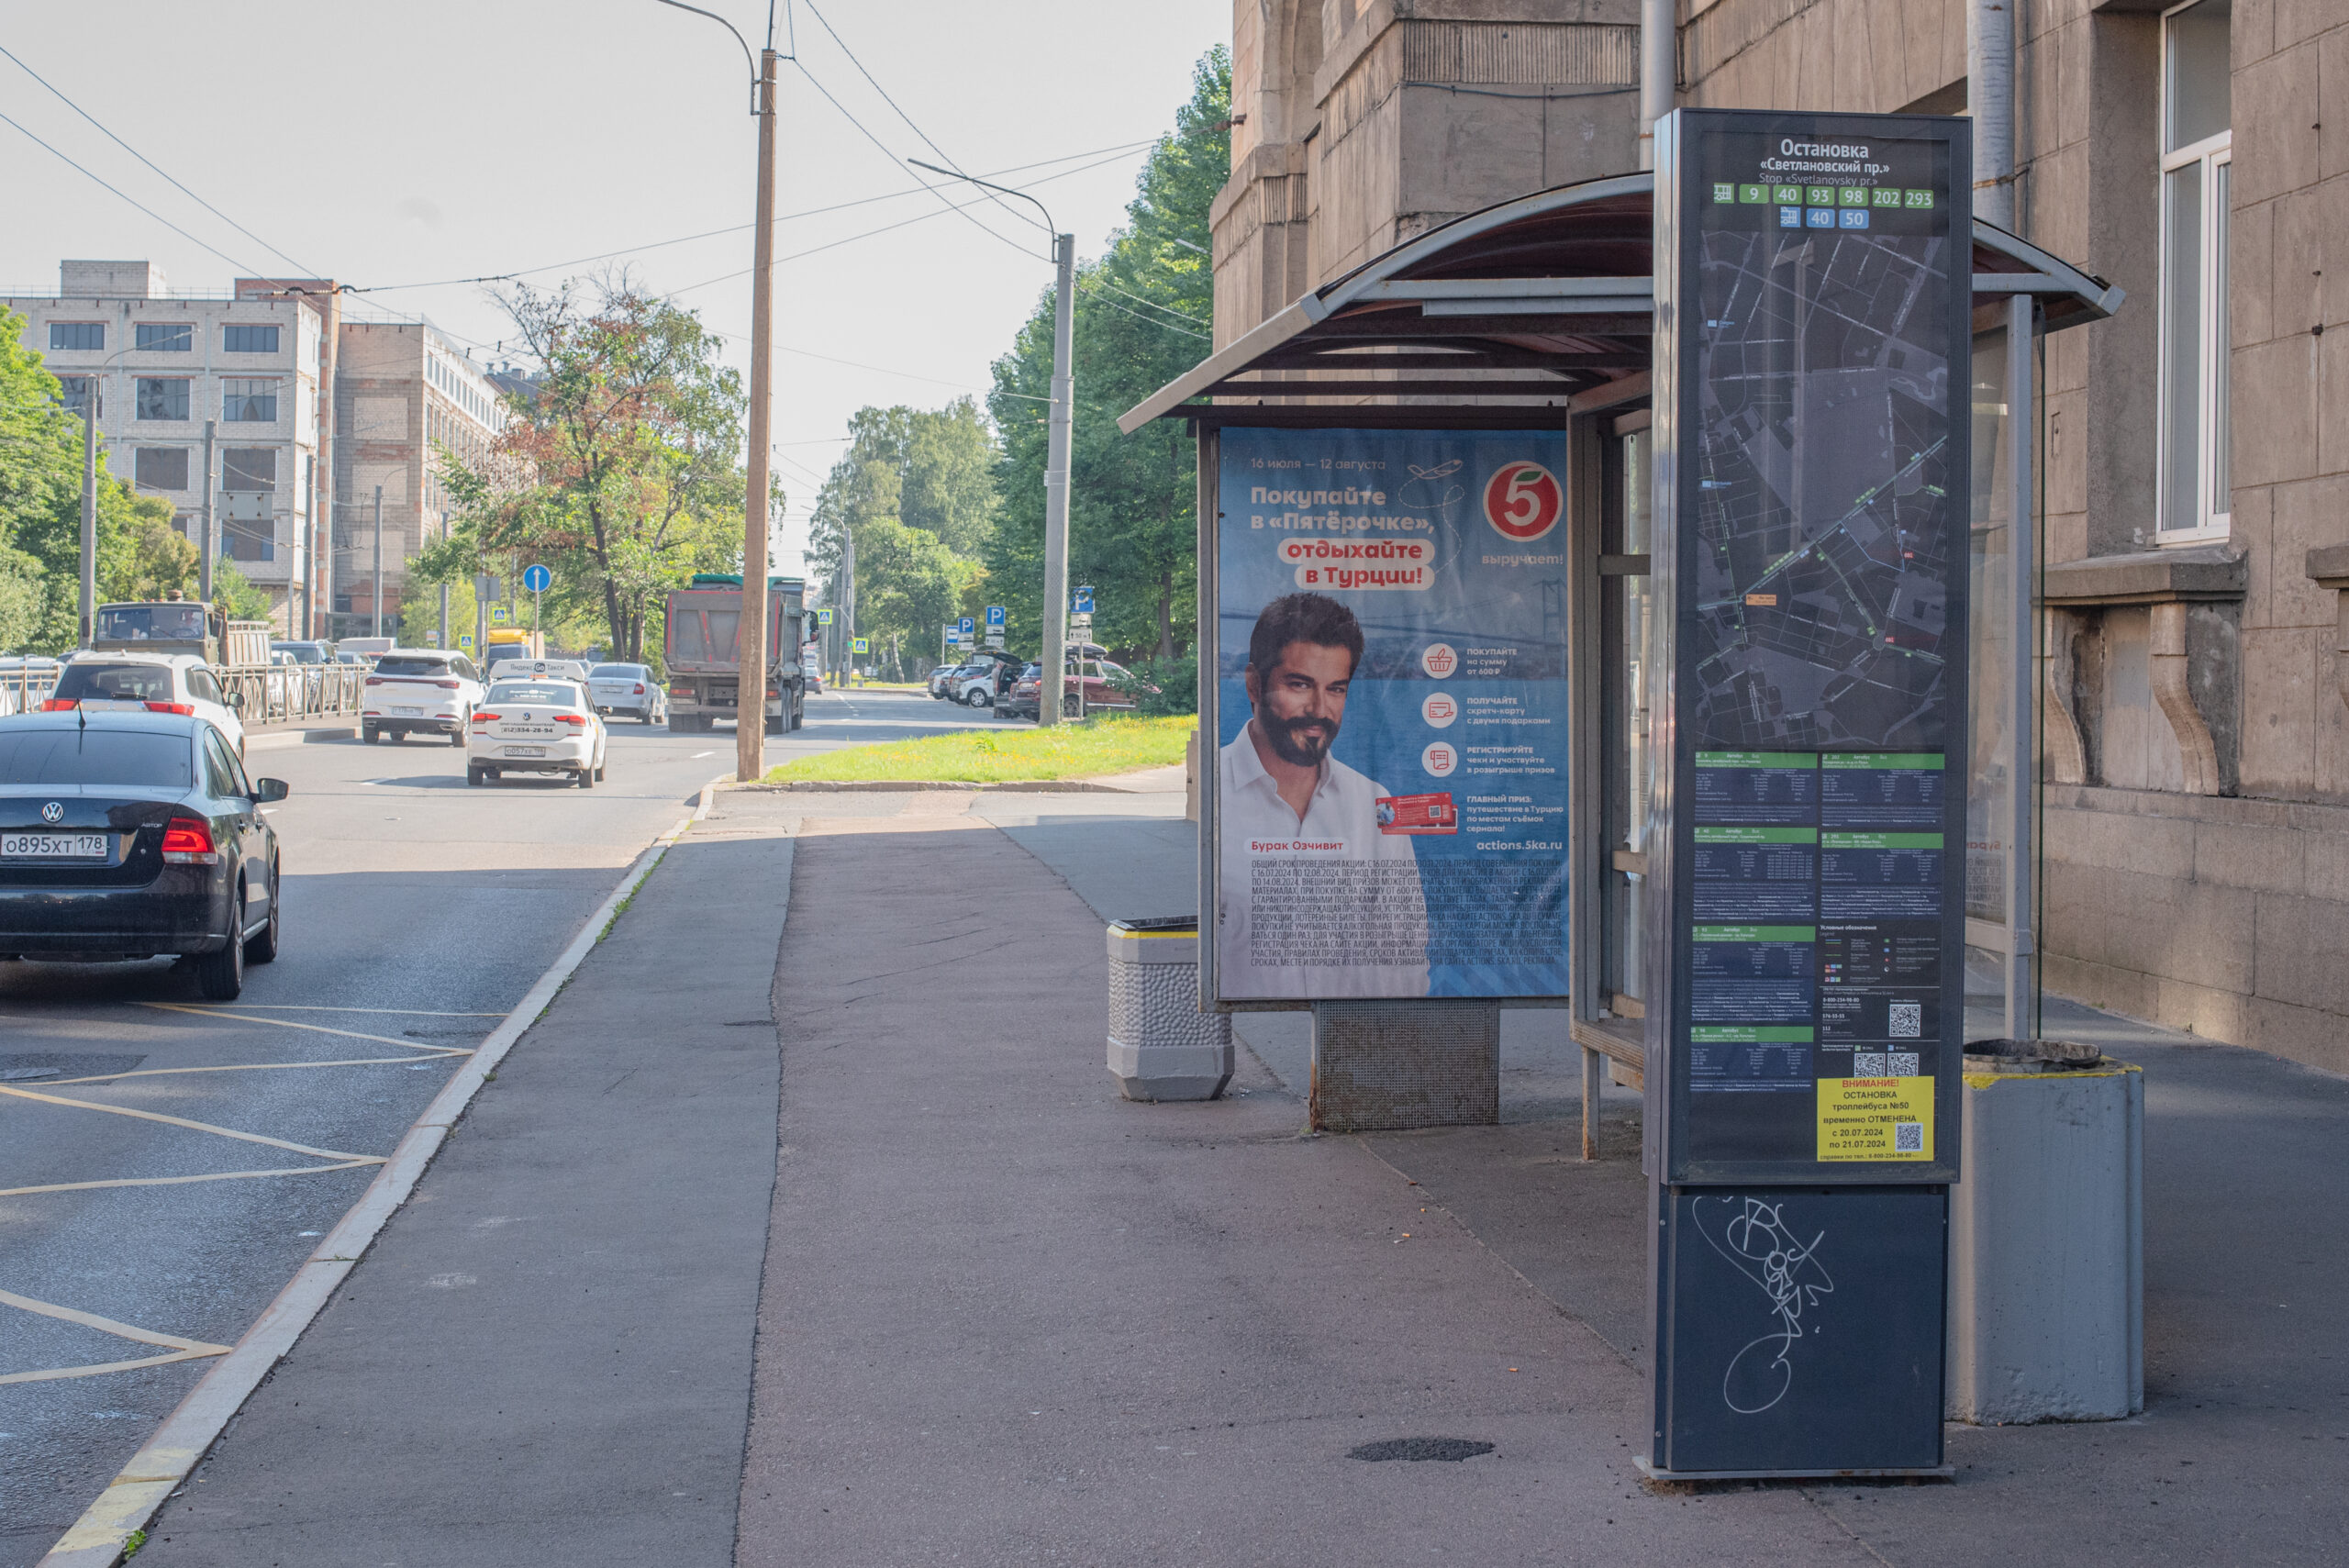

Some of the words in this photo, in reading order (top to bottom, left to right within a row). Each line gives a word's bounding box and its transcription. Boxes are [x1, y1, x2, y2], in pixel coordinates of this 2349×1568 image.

[1780, 139, 1869, 159] Остановка
[1760, 158, 1861, 173] «Светлановский
[1865, 163, 1890, 174] пр.»
[1759, 173, 1783, 184] Stop
[1786, 174, 1857, 187] «Svetlanovsky
[1860, 178, 1878, 187] pr.»
[1750, 188, 1758, 200] 9
[1778, 189, 1797, 201] 40
[1812, 189, 1829, 202] 93
[1845, 191, 1864, 203] 98
[1875, 192, 1899, 204] 202
[1907, 193, 1932, 206] 293
[1811, 212, 1829, 224] 40
[1845, 213, 1864, 225] 50
[1250, 458, 1264, 469] 16
[1267, 461, 1301, 469] июля
[1319, 459, 1331, 470] 12
[1335, 461, 1386, 473] августа
[1251, 486, 1386, 509] Покупайте
[1251, 516, 1264, 529] в
[1269, 510, 1434, 535] «Пятёрочке»,
[1286, 539, 1422, 559] отдыхайте
[1482, 554, 1564, 567] выручает!
[1305, 569, 1319, 584] в
[1323, 567, 1422, 588] Турции!
[991, 609, 1001, 623] P
[963, 620, 971, 631] P
[1467, 647, 1518, 656] ПОКУПАЙТЕ
[1479, 659, 1508, 667] сумму
[1467, 695, 1518, 705] ПОЛУЧАЙТЕ
[1467, 745, 1534, 754] РЕГИСТРИРУЙТЕ
[1497, 756, 1545, 765] участвуйте
[1467, 795, 1507, 803] ГЛАВНЫЙ
[1530, 806, 1564, 814] Турцию
[1466, 825, 1505, 834] сериала!
[6, 837, 72, 853] О895ХТ
[77, 837, 103, 850] 178
[1252, 841, 1288, 852] Бурак
[1292, 841, 1343, 851] Озчивит
[1476, 840, 1563, 851] actions.5ka.ru
[1278, 860, 1296, 868] СРОК
[1297, 860, 1341, 869] ПРОВЕДЕНИЯ
[1842, 1079, 1899, 1088] ВНИМАНИЕ!
[1843, 1091, 1898, 1099] ОСТАНОВКА
[1832, 1103, 1887, 1112] троллейбуса
[1840, 1129, 1883, 1137] 20.07.2024
